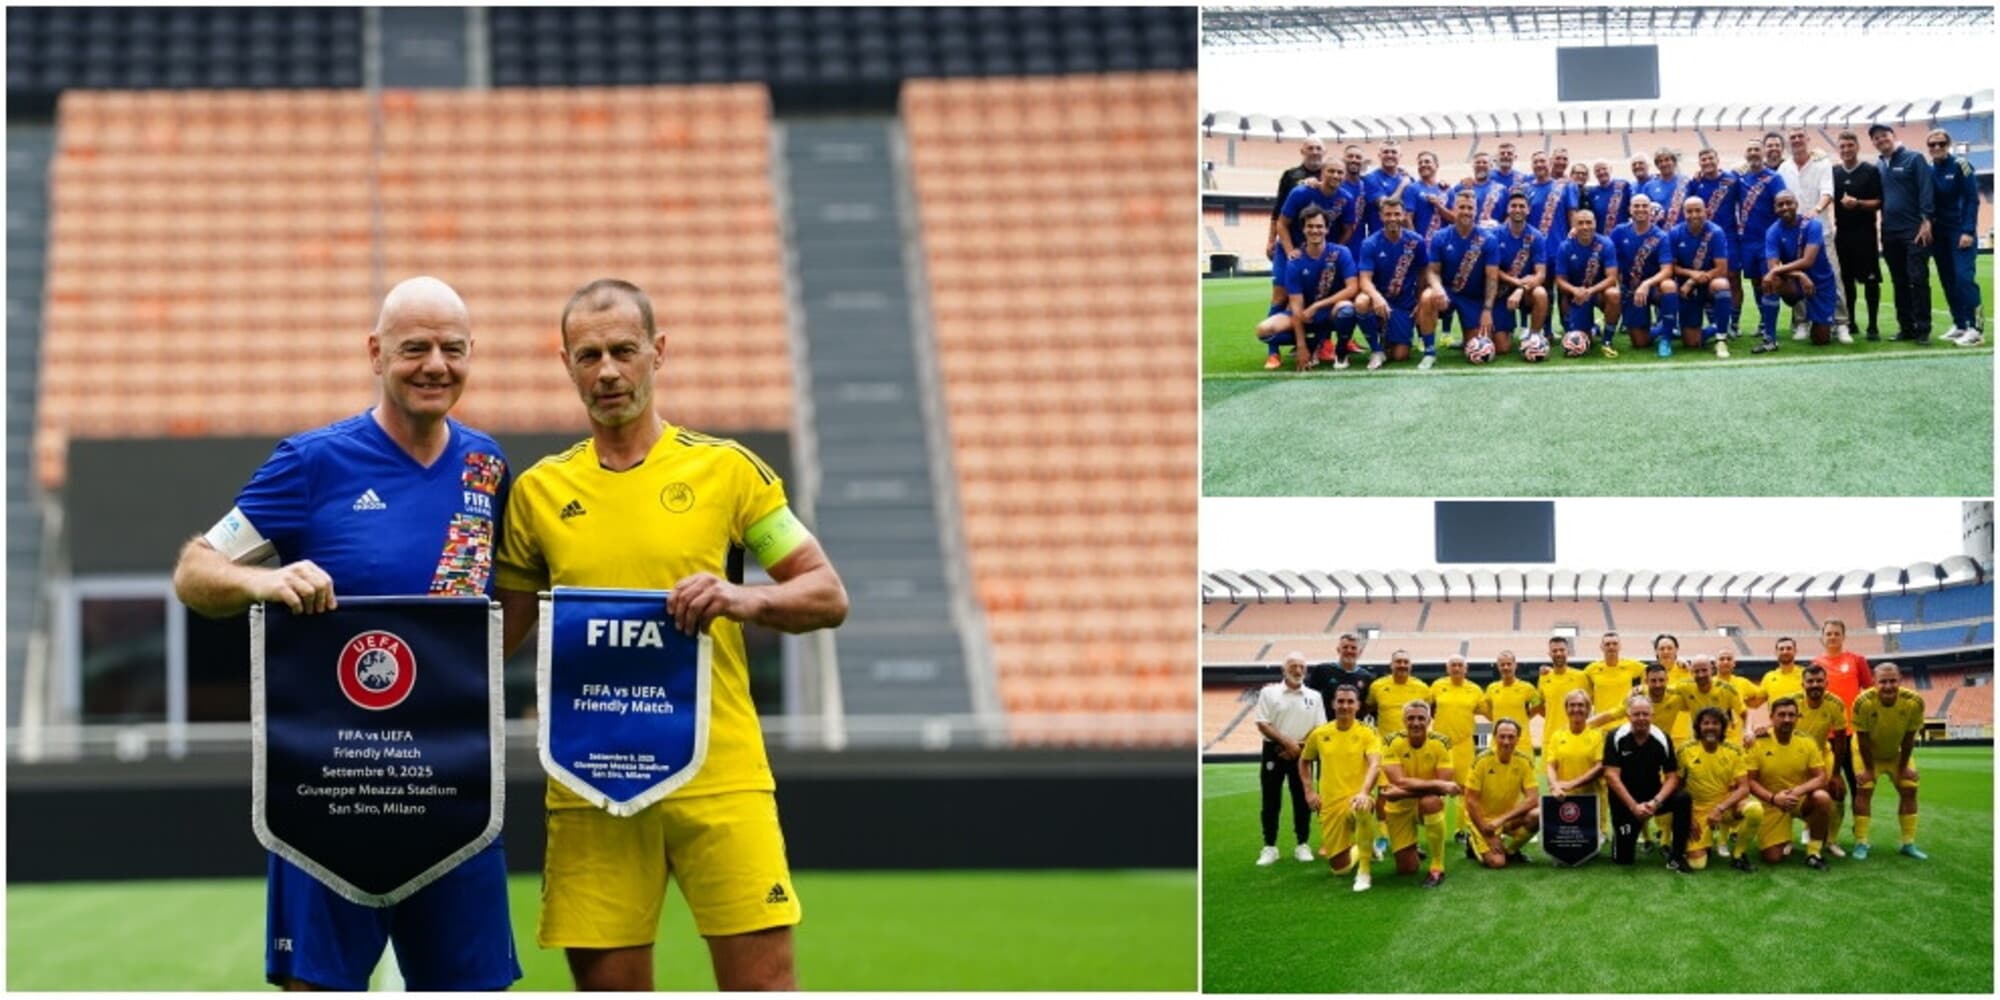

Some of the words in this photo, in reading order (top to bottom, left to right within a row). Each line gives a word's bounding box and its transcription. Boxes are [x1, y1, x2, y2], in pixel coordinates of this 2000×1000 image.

[463, 491, 491, 508] FIFA
[587, 619, 664, 648] FIFA
[353, 635, 400, 654] UEFA
[582, 684, 611, 697] FIFA
[613, 687, 629, 698] vs
[631, 686, 666, 698] UEFA
[573, 699, 629, 715] Friendly
[631, 700, 674, 714] Match
[338, 730, 364, 741] FIFA
[365, 731, 379, 741] vs
[380, 730, 413, 741] UEFA
[333, 747, 380, 760] Friendly
[383, 747, 421, 759] Match
[322, 765, 384, 778] Settembre
[400, 765, 433, 778] 2025
[296, 783, 356, 798] Giuseppe
[358, 784, 405, 796] Meazza
[407, 783, 457, 796] Stadium
[328, 803, 351, 815] San
[353, 803, 381, 816] Siro,
[383, 803, 426, 815] Milano
